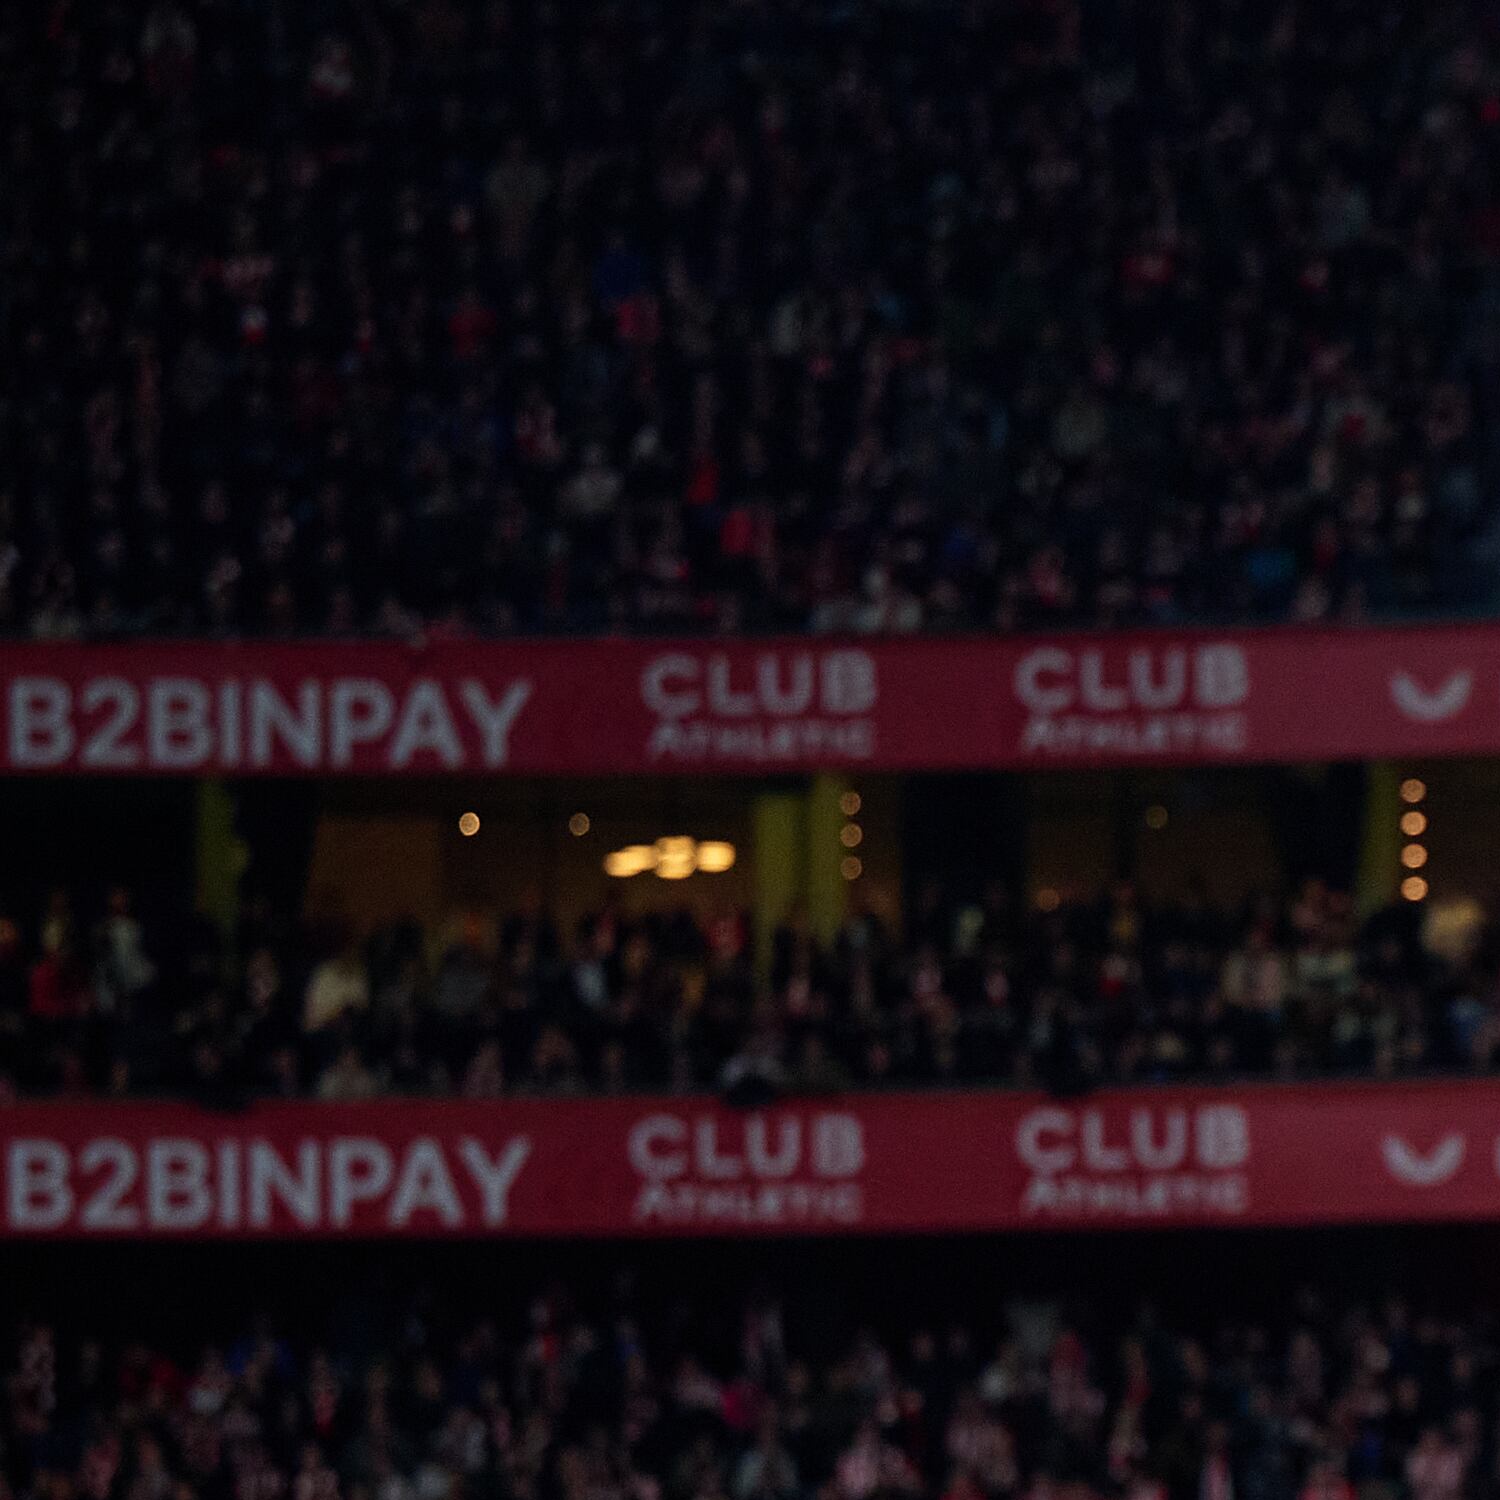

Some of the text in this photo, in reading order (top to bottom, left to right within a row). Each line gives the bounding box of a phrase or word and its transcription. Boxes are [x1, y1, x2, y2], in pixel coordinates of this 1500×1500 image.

[641, 649, 879, 717] CLUB
[1014, 642, 1252, 712] CLUB
[8, 677, 531, 768] B2BINPAY
[628, 1112, 866, 1181] CLUB
[1016, 1103, 1252, 1173] CLUB
[7, 1137, 531, 1229] B2BINPAY
